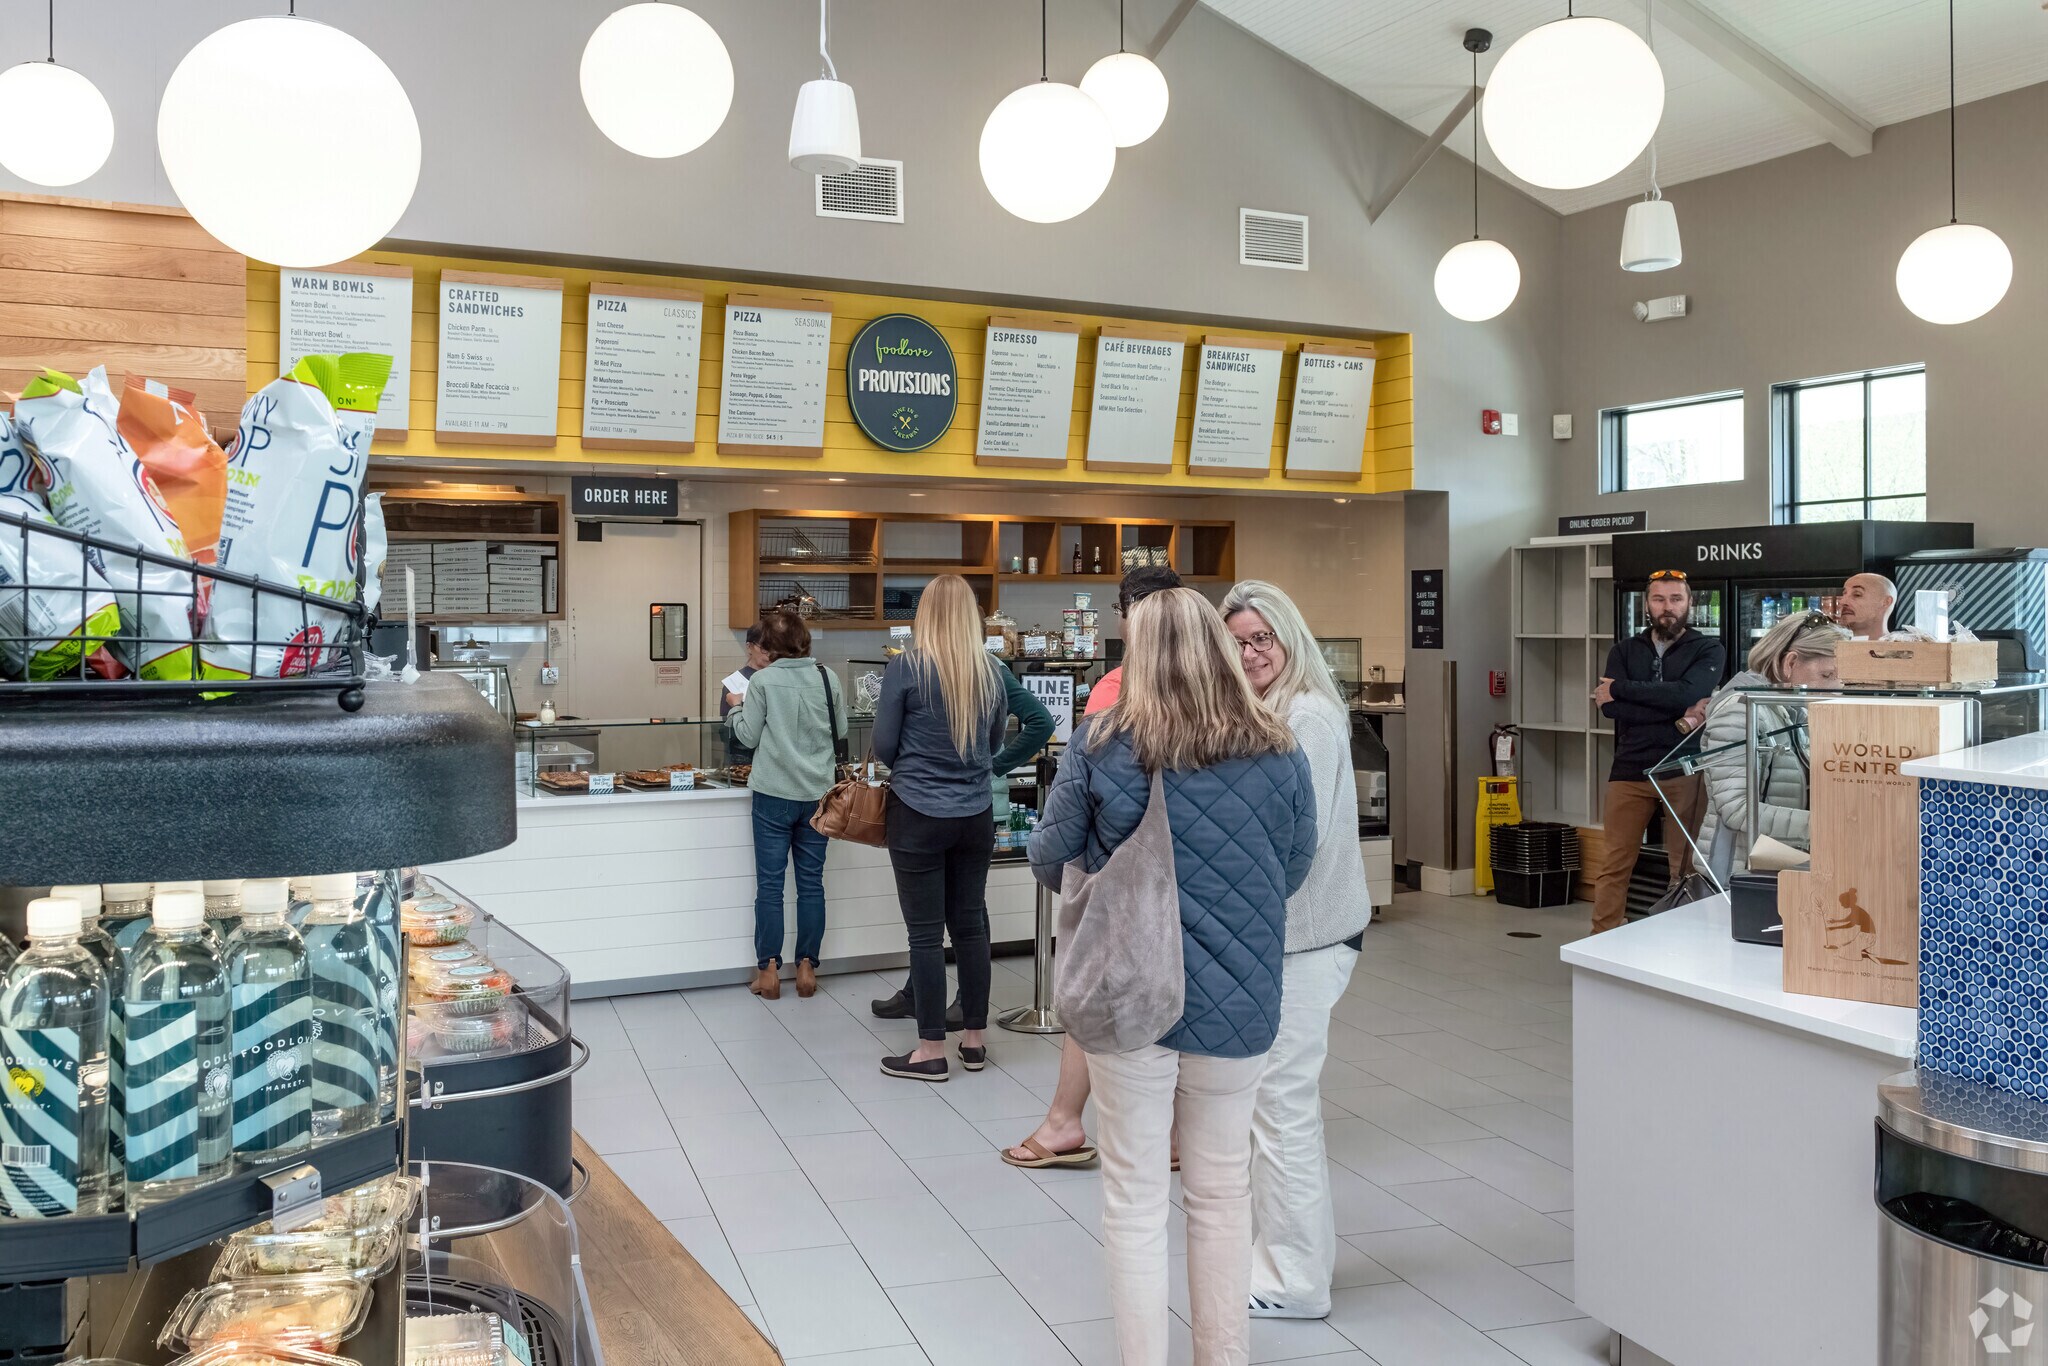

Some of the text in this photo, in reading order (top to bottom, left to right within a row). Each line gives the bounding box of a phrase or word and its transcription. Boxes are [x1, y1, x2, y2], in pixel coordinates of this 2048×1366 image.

[292, 277, 374, 293] WARM BOWLS
[449, 289, 499, 303] CRAFTED
[291, 300, 328, 309] Korean Bowl
[448, 302, 524, 317] SANDWICHES
[597, 300, 696, 319] PIZZA CLASSICS
[734, 311, 826, 328] PIZZA SEASONAL
[291, 328, 343, 338] Fall Harvest Bowl
[448, 323, 469, 331] Chicken
[595, 337, 619, 346] Pepperoni
[993, 332, 1037, 344] ESPRESSO
[876, 336, 933, 363] foodlove
[1105, 341, 1172, 356] CAFÉ BEVERAGES
[466, 353, 482, 361] Swiss
[1207, 350, 1250, 362] BREAKFAST
[1206, 361, 1256, 373] SANDWICHES
[1305, 358, 1363, 370] BOTTLES CANS
[859, 369, 951, 396] PROVISIONS
[1302, 376, 1314, 384] BEER
[605, 398, 628, 406] Prosciutto
[892, 407, 906, 418] DINE
[892, 426, 919, 439] TAKEAWAY
[1296, 425, 1317, 433] BUBBLES
[584, 488, 667, 504] ORDER HERE
[1570, 516, 1634, 529] ONLINE ORDER PICKUP
[1697, 543, 1762, 561] DRINKS
[1027, 680, 1069, 694] LINE
[1036, 697, 1069, 705] ARTS
[1833, 742, 1912, 759] WORLD
[1823, 760, 1897, 775] CENTR
[0, 1056, 73, 1071] OODLOVE
[266, 1079, 302, 1092] MARKET
